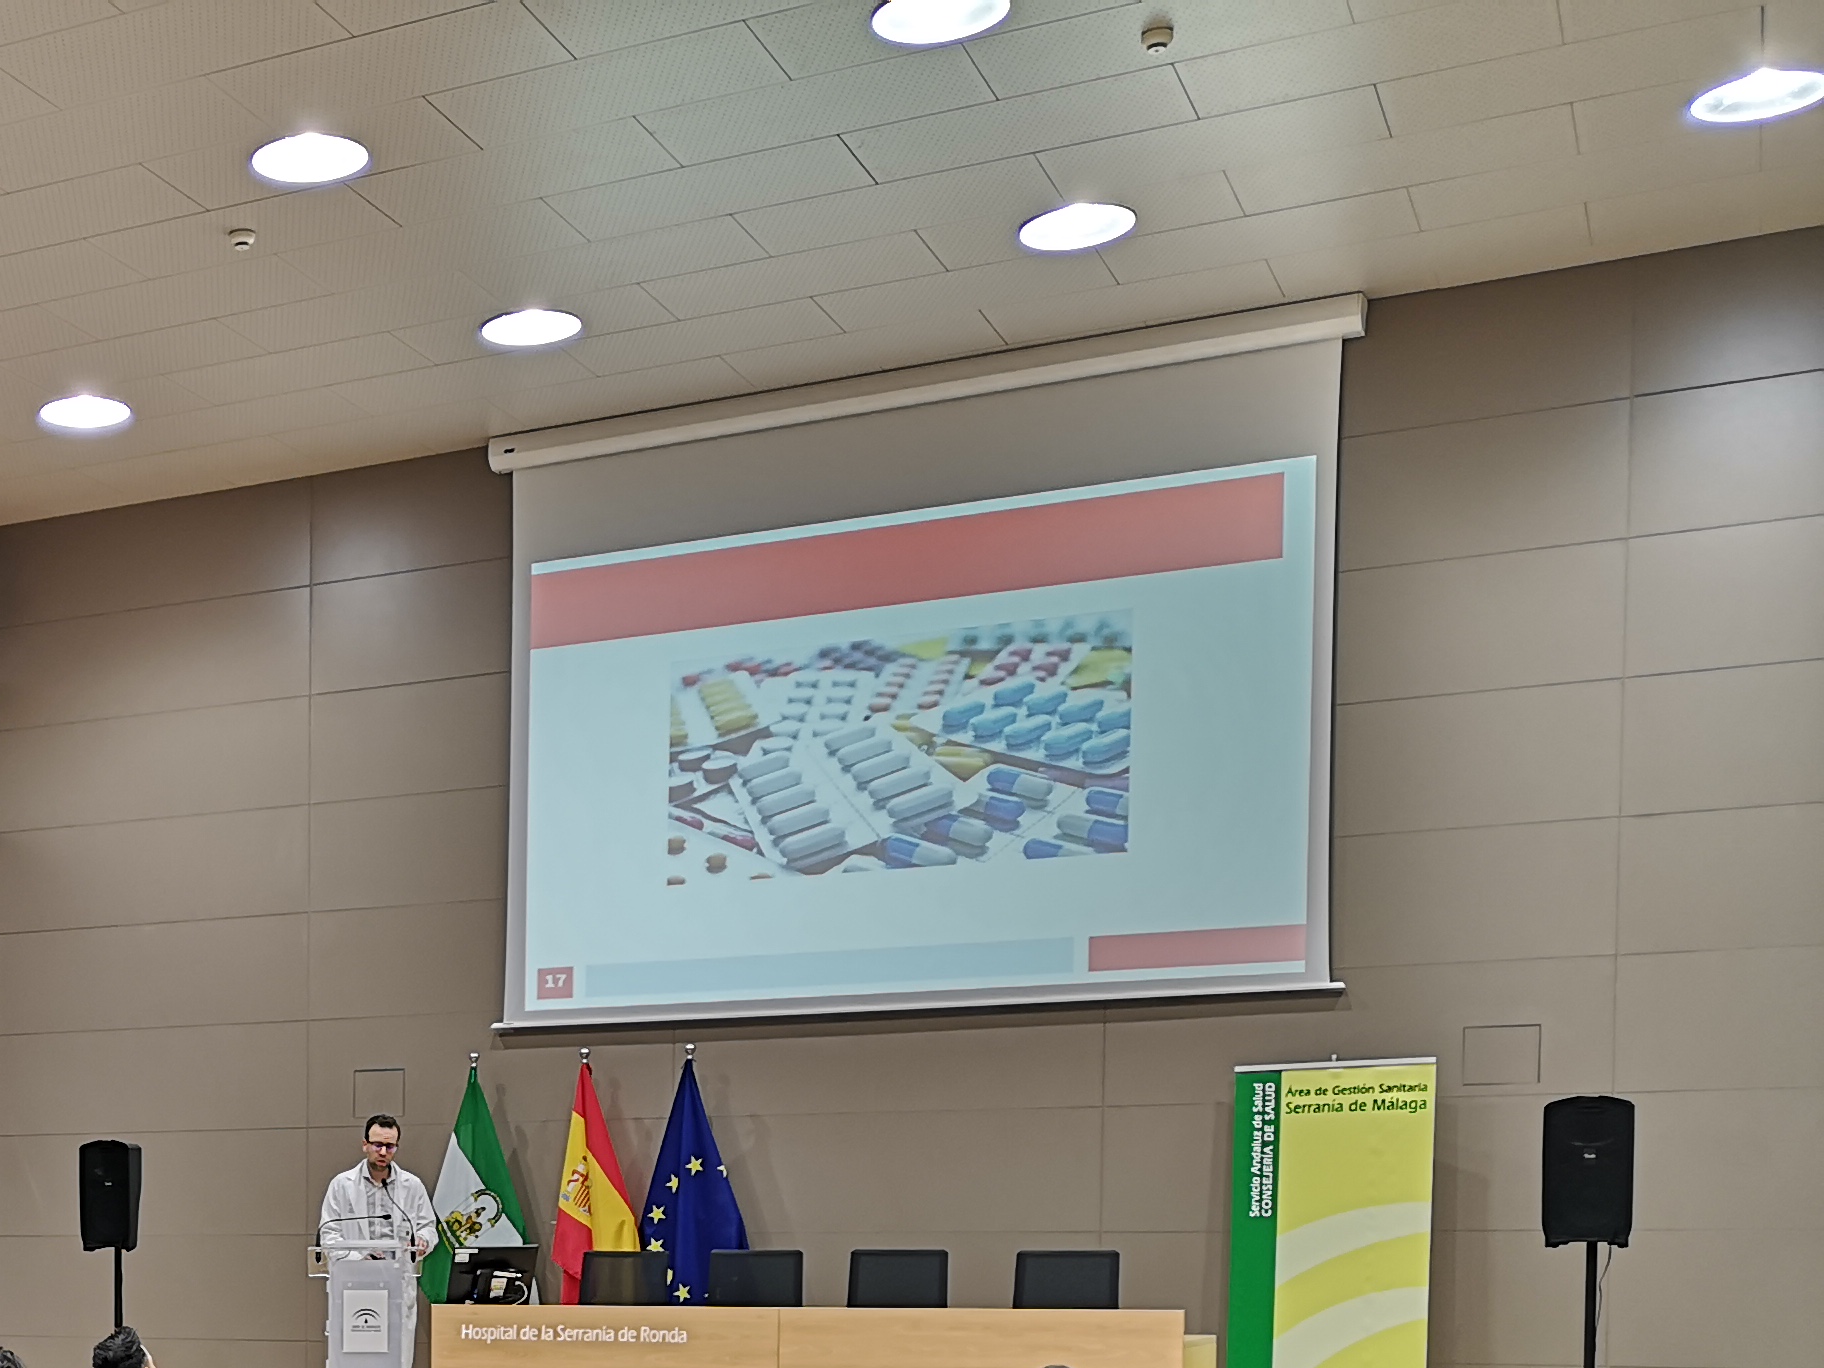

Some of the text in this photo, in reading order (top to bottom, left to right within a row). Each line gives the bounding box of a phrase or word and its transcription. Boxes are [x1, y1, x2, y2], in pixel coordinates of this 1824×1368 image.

[545, 973, 567, 988] 17
[1285, 1083, 1428, 1098] Área de Gestión Sanitaria
[1264, 1082, 1276, 1120] SALUD
[1285, 1097, 1427, 1114] Serranía de Málaga
[1263, 1124, 1274, 1141] DE
[1249, 1082, 1263, 1217] Servicio Andaluz de Salud
[461, 1324, 688, 1344] Hospital de la Serranía de Ronda
